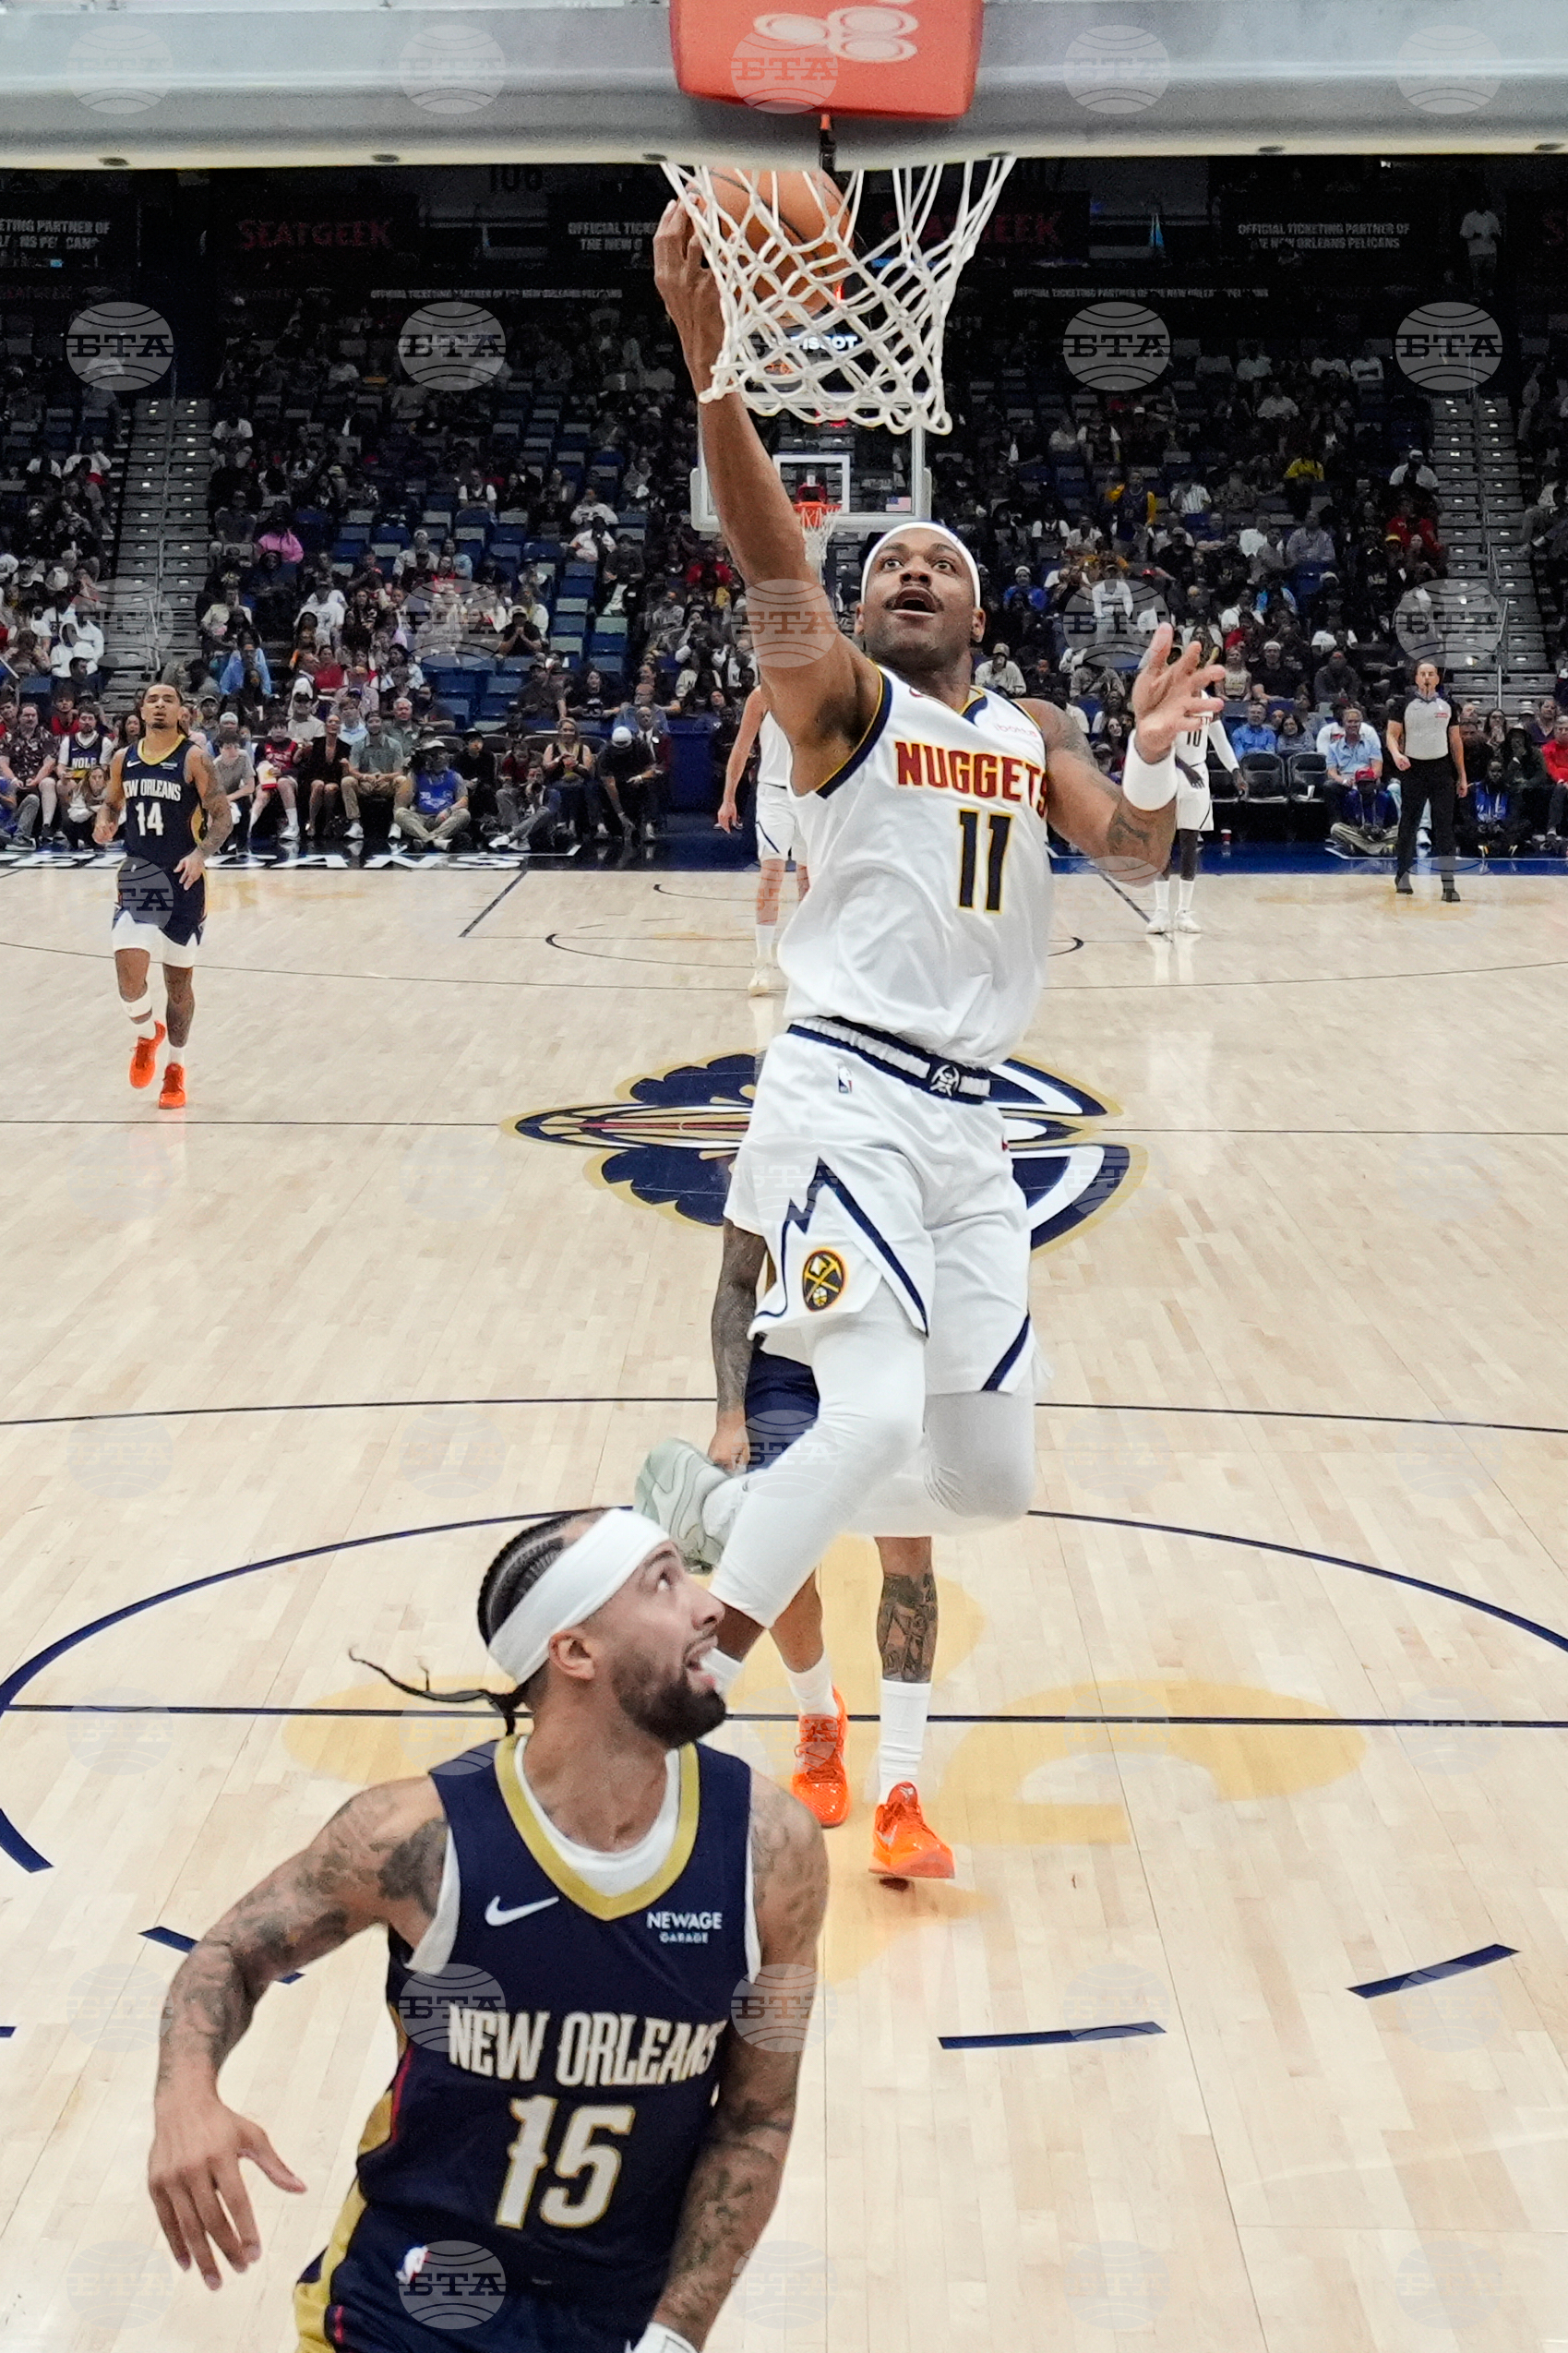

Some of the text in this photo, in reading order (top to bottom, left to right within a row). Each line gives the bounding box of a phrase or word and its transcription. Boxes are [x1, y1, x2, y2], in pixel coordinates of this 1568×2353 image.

[95, 221, 111, 234] OF
[1238, 223, 1286, 235] OFFICIAL
[1287, 223, 1343, 235] TICKETING
[1346, 223, 1394, 235] PARTNER
[1347, 237, 1400, 250] PELICANS
[122, 778, 182, 802] EW ORLEANS
[135, 801, 164, 836] 14
[957, 808, 1016, 915] 11
[646, 1911, 723, 1930] NEWAGE
[659, 1931, 709, 1944] GARAGE
[449, 2001, 551, 2082] NEW
[495, 2094, 637, 2230] 15
